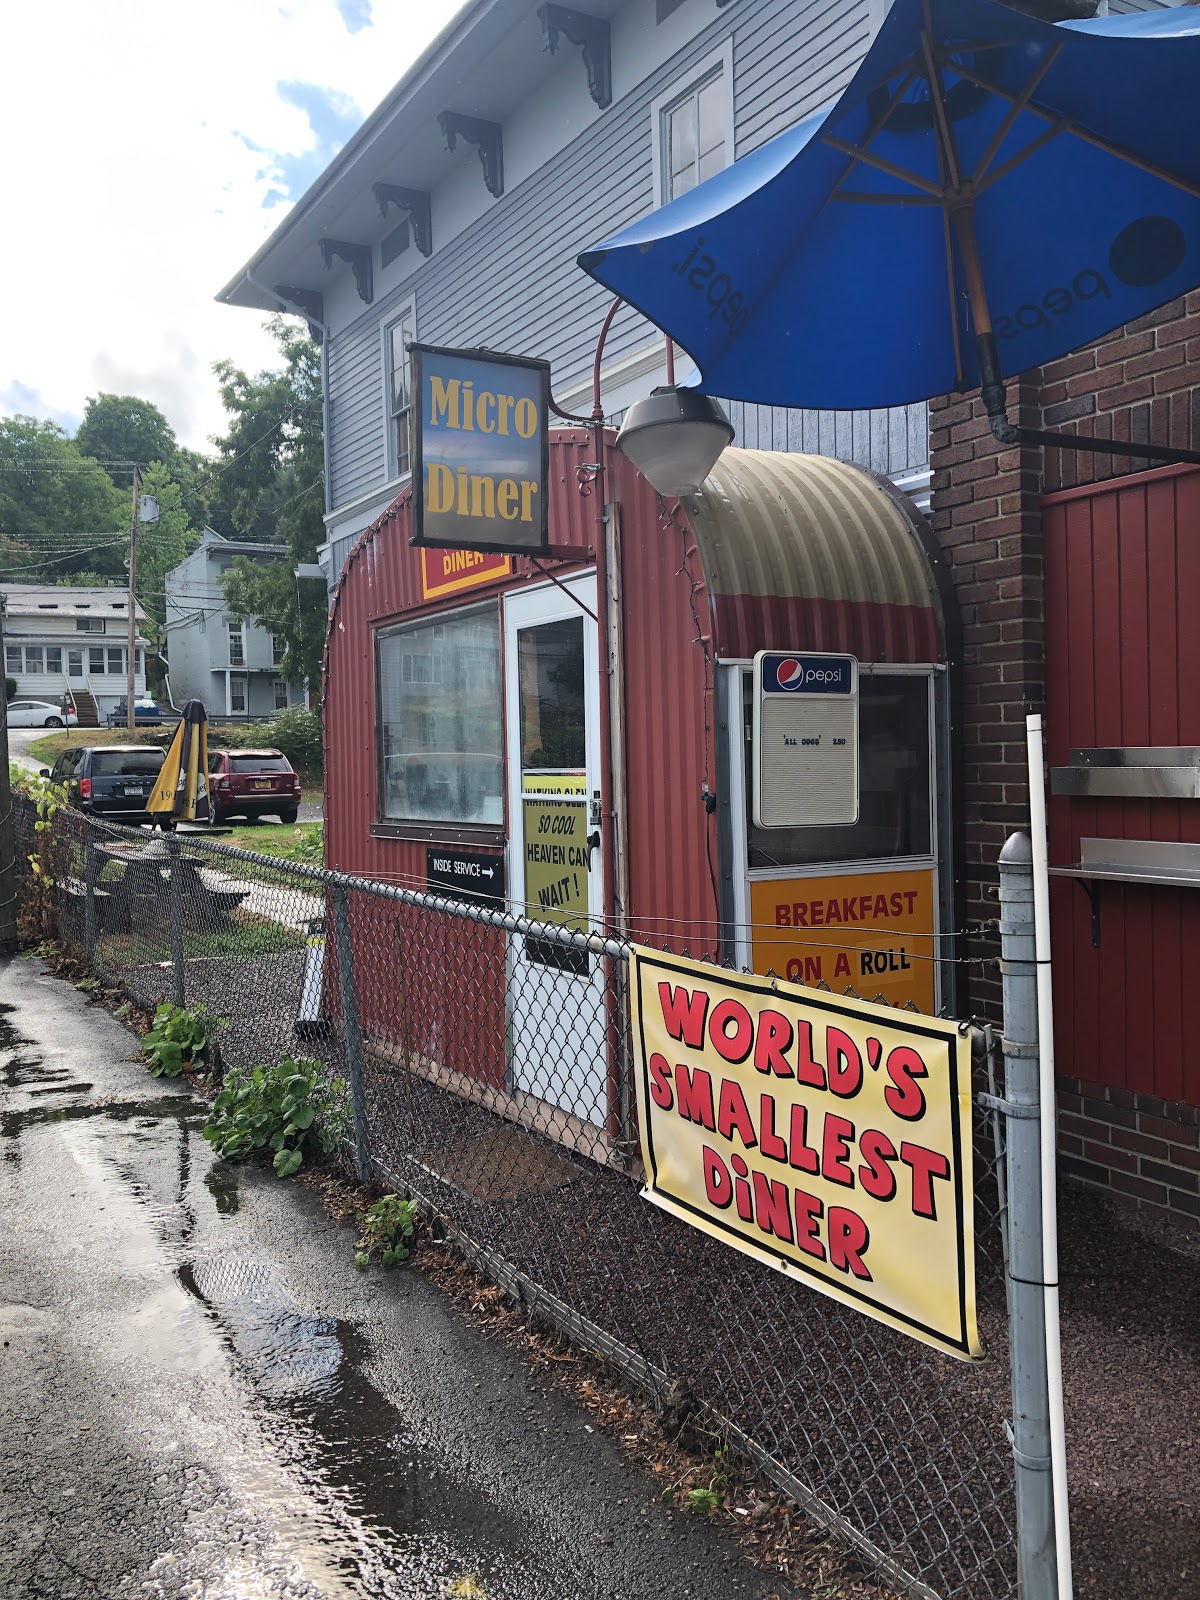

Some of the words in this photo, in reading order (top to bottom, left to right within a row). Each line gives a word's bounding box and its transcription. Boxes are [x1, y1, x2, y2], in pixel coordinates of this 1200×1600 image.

[429, 375, 538, 439] Micro
[426, 463, 538, 522] Diner
[805, 668, 842, 684] pepsi
[538, 814, 551, 835] SO
[551, 815, 576, 836] COOL
[433, 858, 452, 873] INSIDE
[453, 860, 481, 877] SERVICE
[527, 843, 566, 866] HEAVEN
[568, 846, 588, 868] CAN
[538, 876, 570, 913] WAIT
[775, 890, 918, 930] BREAKFAST
[785, 955, 822, 984] ON
[833, 952, 852, 978] A
[860, 947, 911, 976] ROLL
[657, 981, 929, 1122] WORLD'S
[649, 1052, 951, 1222] SMALLEST
